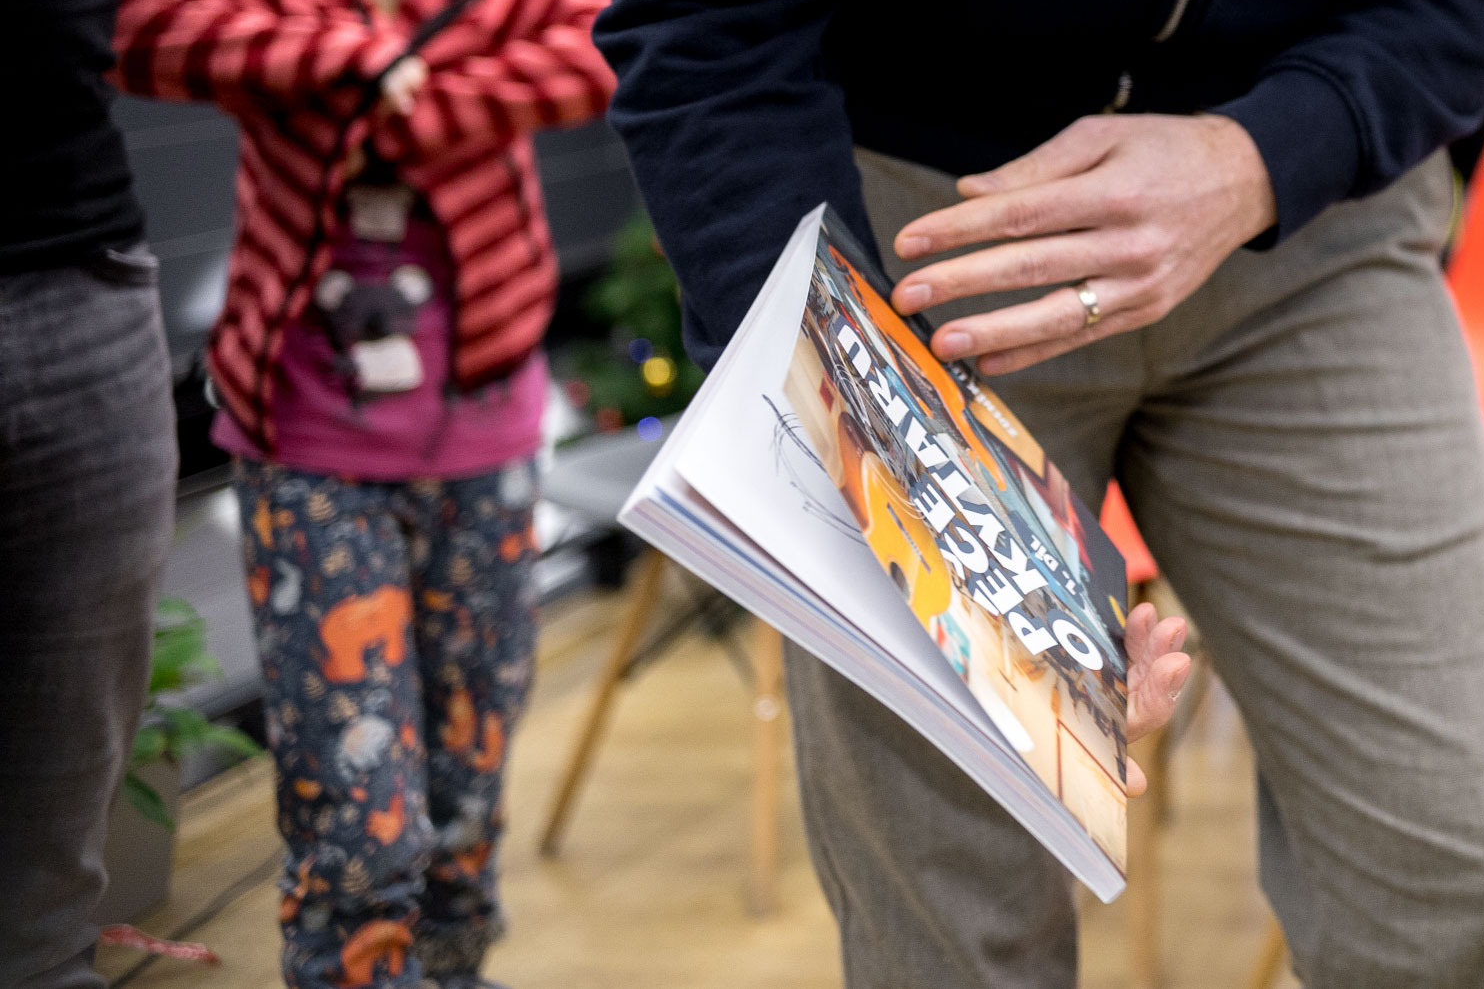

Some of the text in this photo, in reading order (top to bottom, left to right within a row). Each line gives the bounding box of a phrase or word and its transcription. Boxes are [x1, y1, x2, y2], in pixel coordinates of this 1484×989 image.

[838, 324, 1103, 670] O KYTARU
[914, 483, 1058, 656] PÉČE
[1030, 534, 1059, 573] DÍL
